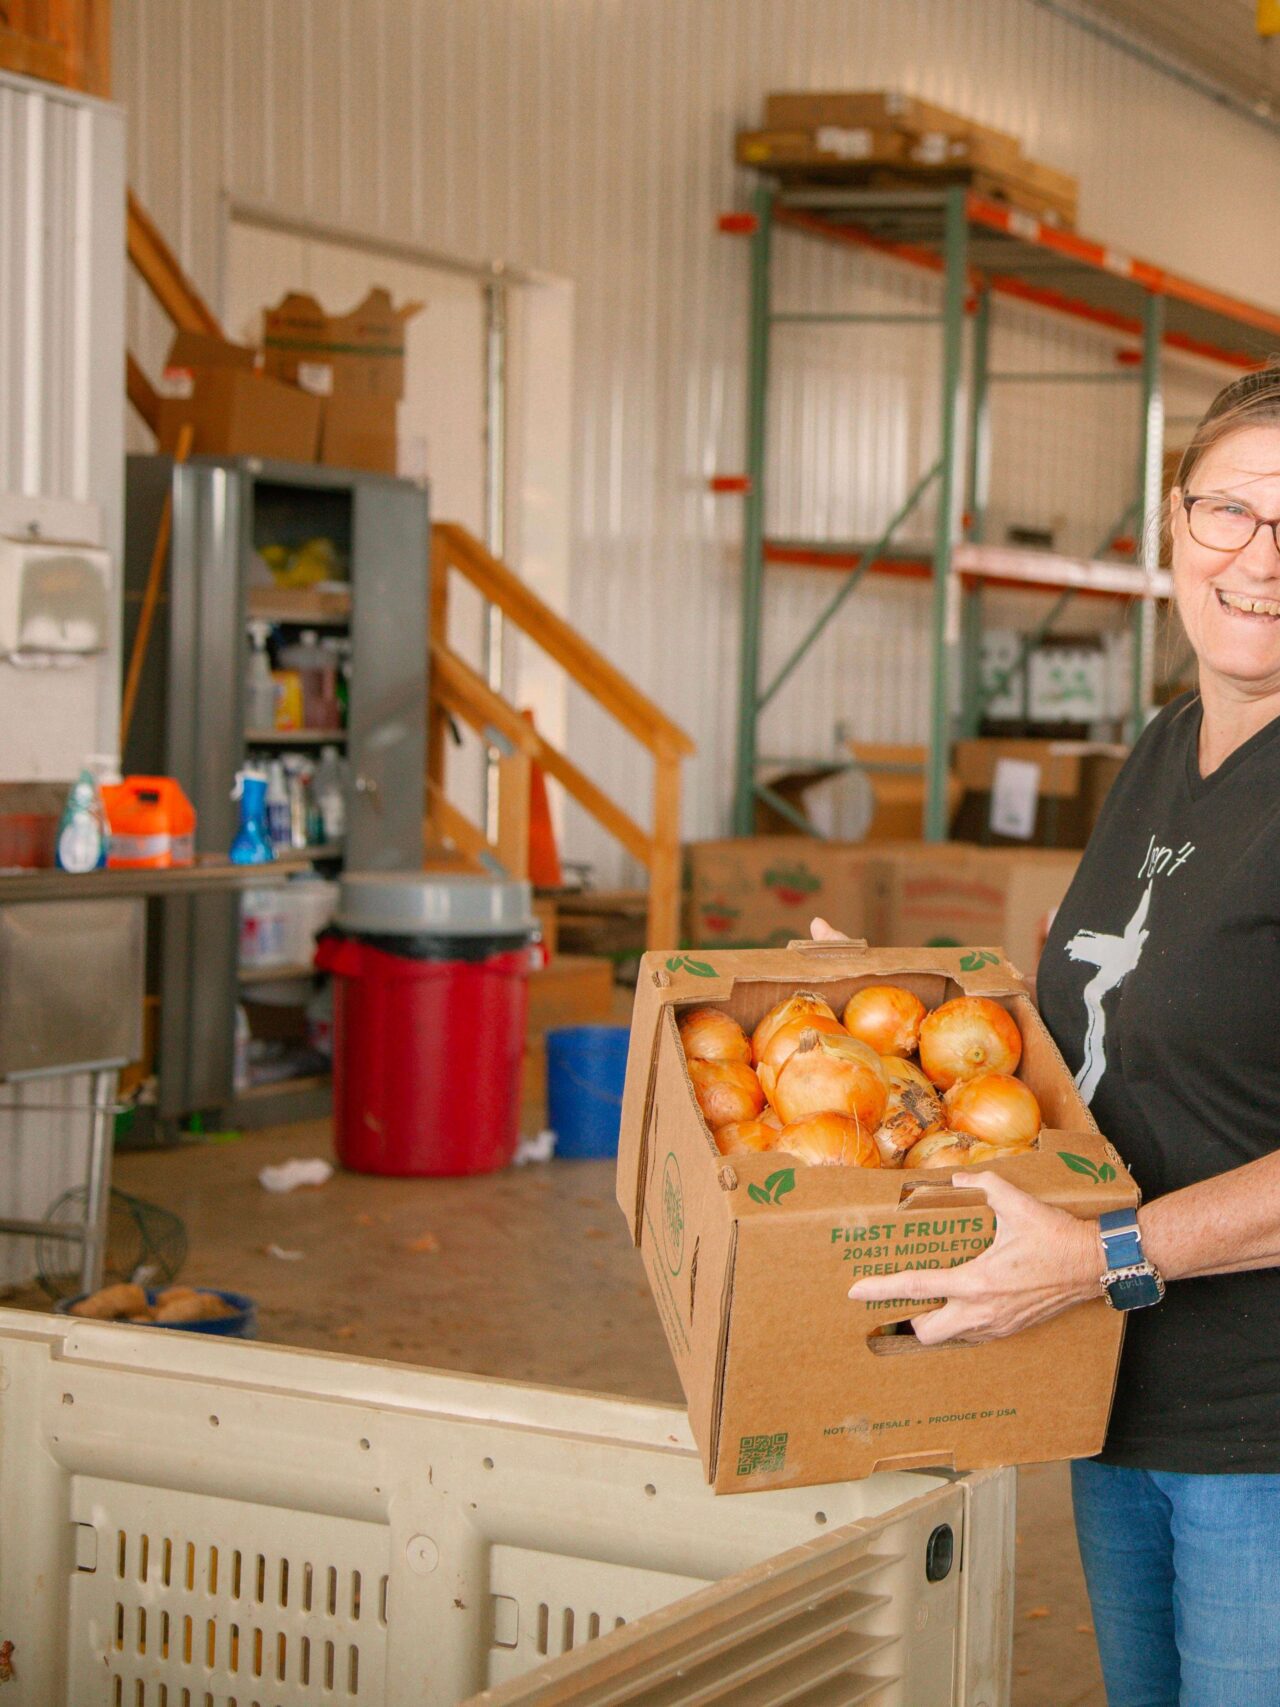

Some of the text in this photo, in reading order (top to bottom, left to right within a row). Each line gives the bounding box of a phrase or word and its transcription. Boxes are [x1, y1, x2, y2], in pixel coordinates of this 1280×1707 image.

[831, 1223, 897, 1243] FIRST
[903, 1217, 984, 1238] FRUITS
[843, 1246, 889, 1261] 20431
[823, 1426, 845, 1436] NOT
[872, 1419, 911, 1431] RESALE
[928, 1411, 978, 1425] PRODUCE
[980, 1409, 994, 1419] OF
[994, 1407, 1017, 1419] USA
